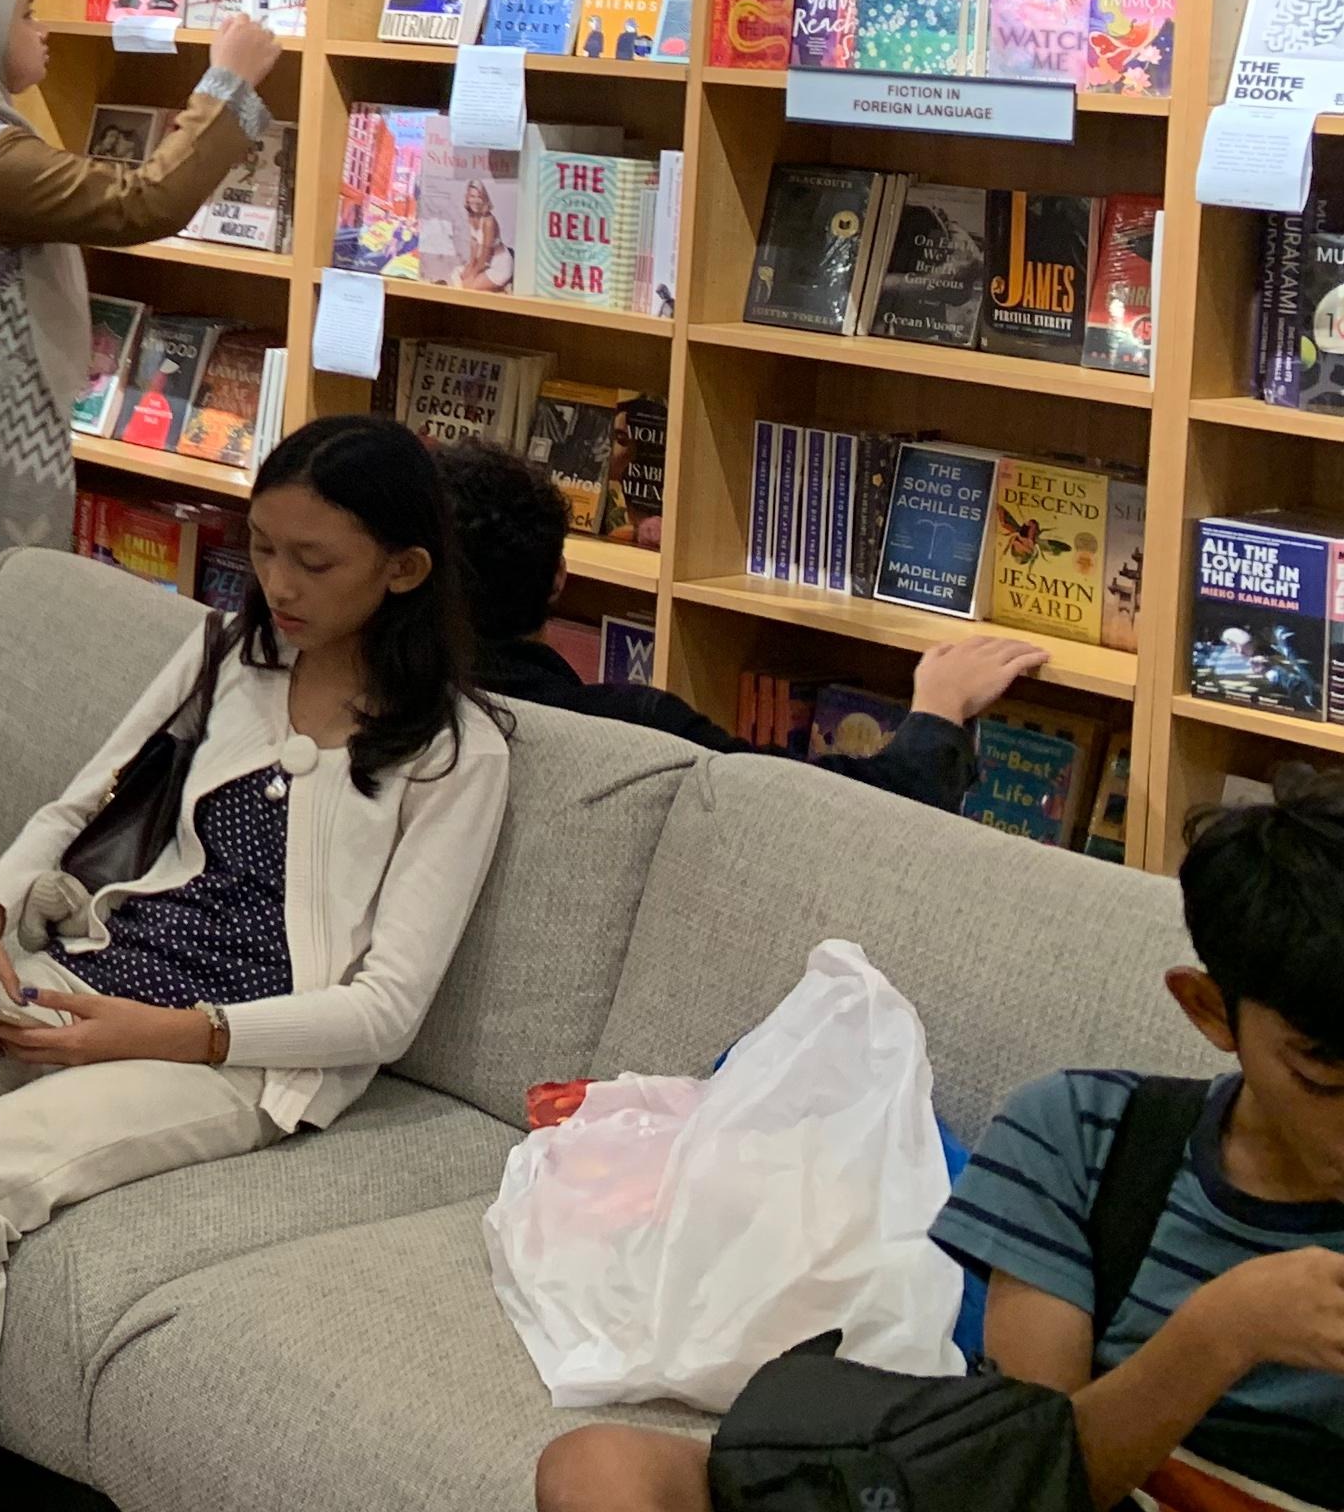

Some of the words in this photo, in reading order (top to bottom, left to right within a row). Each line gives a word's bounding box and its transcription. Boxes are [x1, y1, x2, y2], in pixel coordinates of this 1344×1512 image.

[505, 2, 556, 16] SALLY
[381, 14, 458, 40] INTERMEZZO
[494, 19, 562, 34] ROONEY
[998, 26, 1089, 48] WATCH
[1032, 50, 1069, 71] ME
[1240, 60, 1280, 74] THE
[888, 85, 942, 99] FICTION
[947, 88, 960, 100] IN
[1237, 74, 1304, 89] WHITE
[1234, 87, 1294, 102] BOOK
[854, 100, 912, 114] FOREIGN
[917, 104, 992, 119] LANGUAGE
[427, 151, 468, 169] Sylvia
[556, 162, 605, 193] THE
[548, 211, 611, 245] BELL
[914, 235, 933, 246] On
[990, 191, 1075, 313] JAMES
[552, 262, 604, 294] JAR
[904, 274, 964, 289] Gorgeous
[884, 312, 923, 328] Ocean
[925, 318, 964, 337] Vuong
[433, 354, 502, 381] HEAVEN
[416, 397, 497, 426] GROCERY
[551, 469, 603, 494] Kairos
[929, 463, 961, 481] THE
[903, 477, 952, 496] SONG
[958, 488, 982, 502] OF
[1017, 472, 1057, 492] LET
[1063, 481, 1087, 499] US
[896, 494, 982, 521] ACHILLES
[1004, 489, 1100, 520] DESCEND
[1202, 538, 1238, 557] ALL
[1244, 545, 1278, 564] THE
[888, 561, 968, 587] MADELINE
[1202, 556, 1274, 578] LOVERS
[1279, 566, 1300, 582] IN
[897, 576, 954, 600] MILLER
[999, 567, 1094, 603] JESMYN
[1201, 568, 1235, 587] THE
[1241, 575, 1300, 598] NIGHT
[1009, 591, 1083, 623] WARD
[1239, 593, 1299, 610] KAWAKAMI
[986, 745, 1007, 760] The
[1007, 752, 1052, 780] Best
[993, 780, 1034, 807] Life
